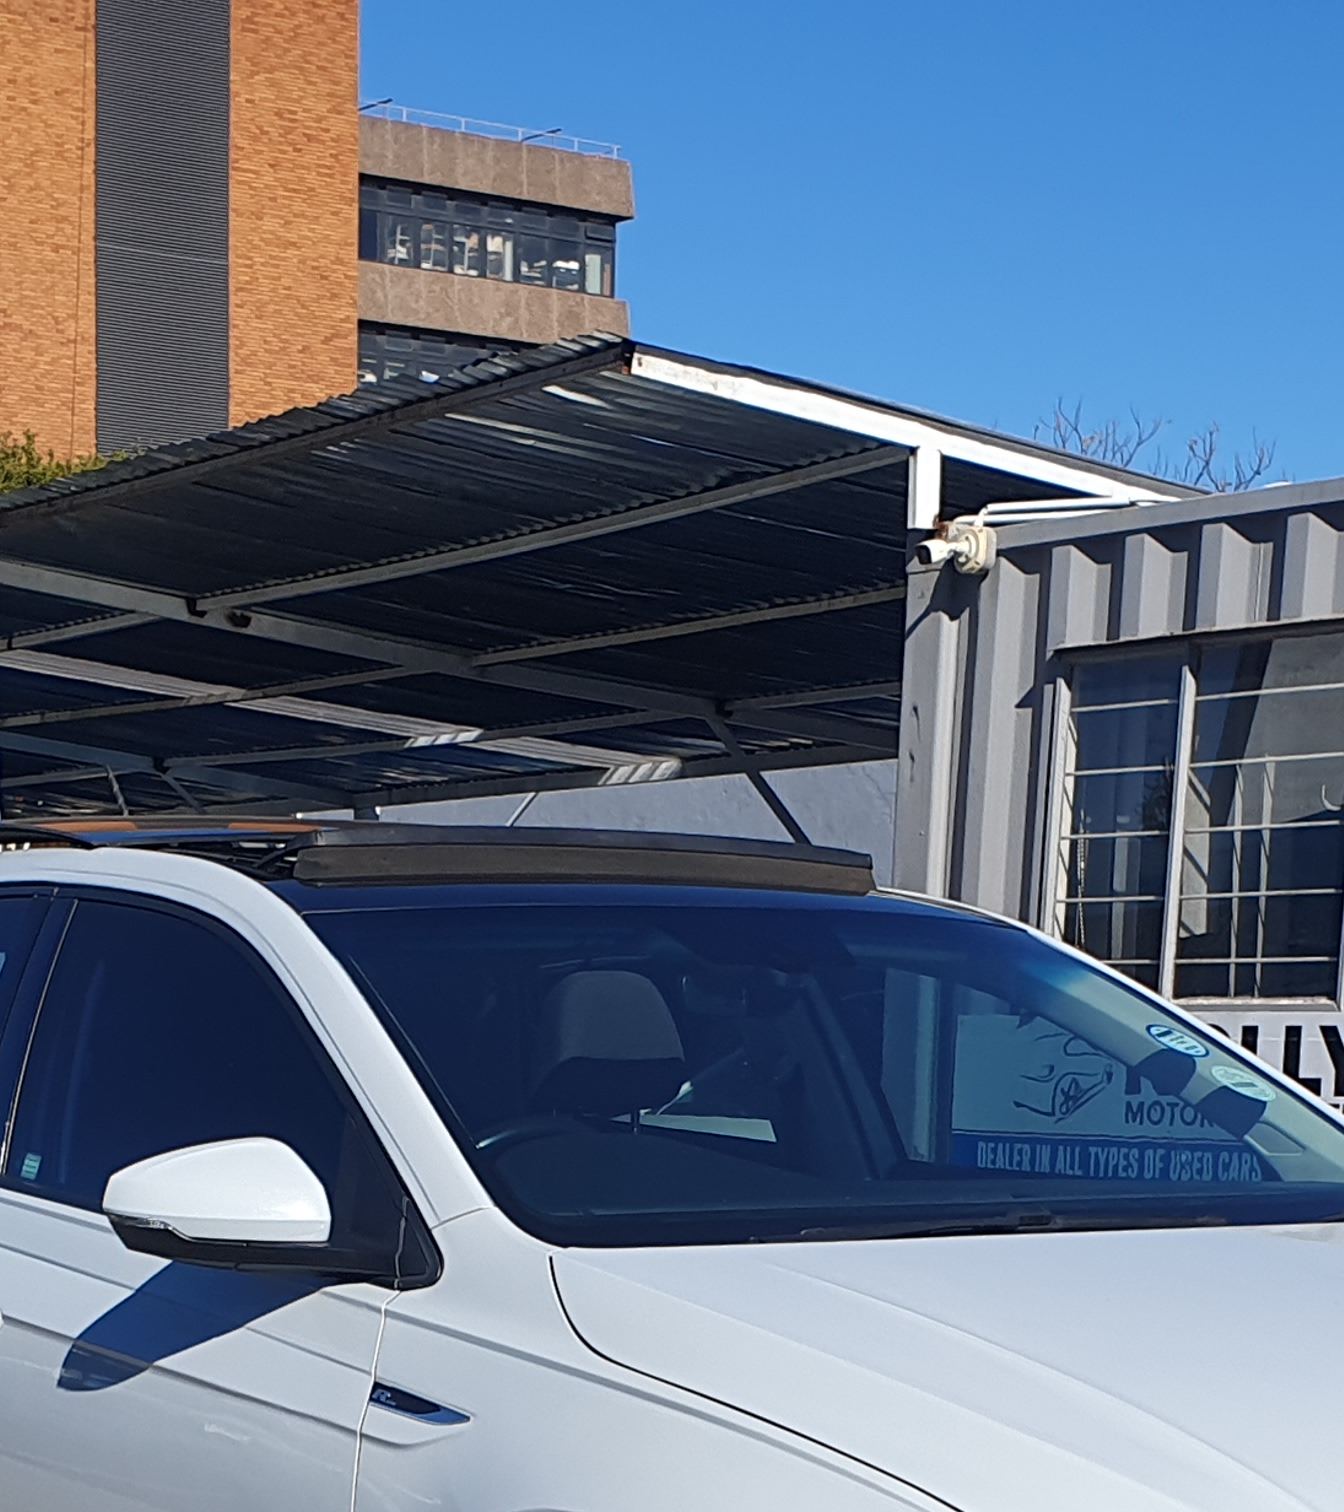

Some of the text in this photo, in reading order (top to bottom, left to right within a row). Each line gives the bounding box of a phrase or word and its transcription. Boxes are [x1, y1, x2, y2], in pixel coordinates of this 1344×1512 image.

[977, 1140, 1262, 1182] DEALER IN ALL TYPES OF USED CARS
